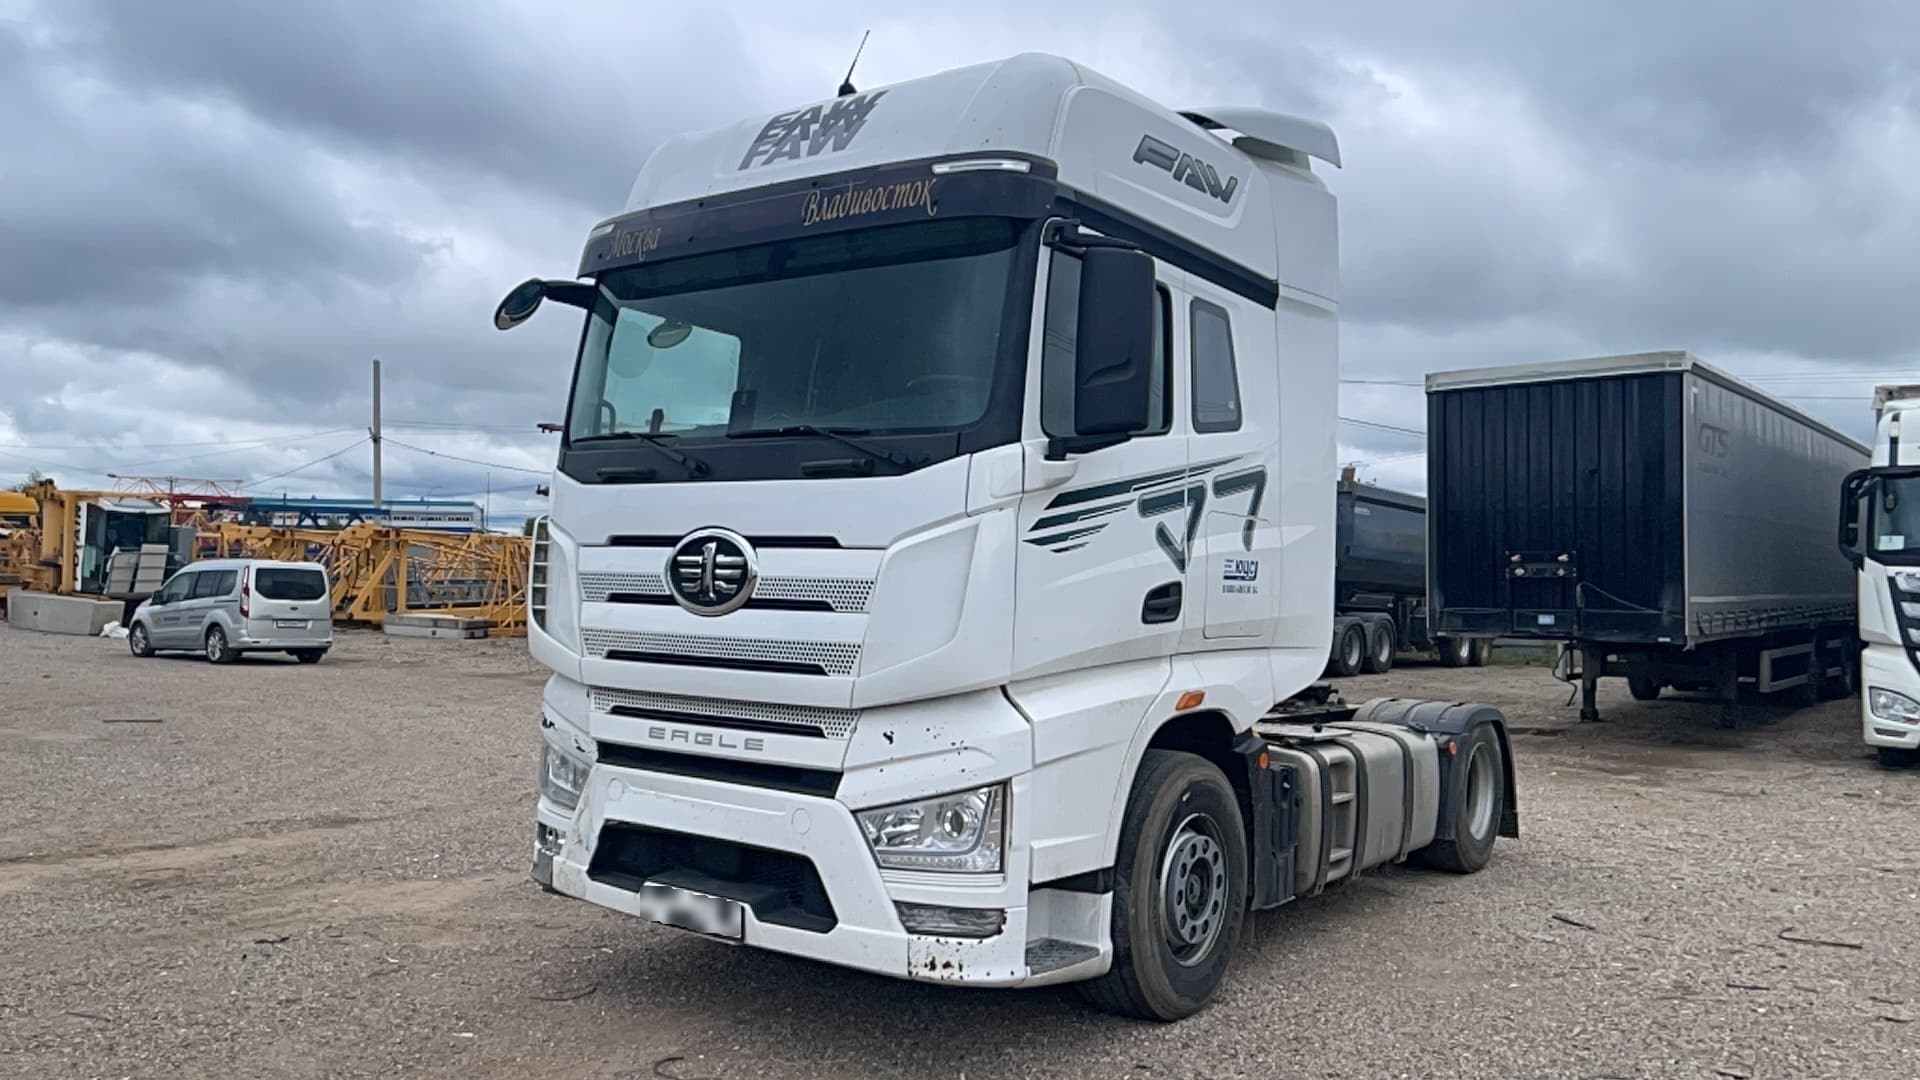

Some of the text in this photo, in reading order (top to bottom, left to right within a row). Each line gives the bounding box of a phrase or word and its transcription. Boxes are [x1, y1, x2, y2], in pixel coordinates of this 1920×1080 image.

[1133, 134, 1238, 204] FAW
[801, 178, 937, 226] Владивосток
[1699, 422, 1729, 458] GTS
[648, 726, 764, 751] EAGLE
